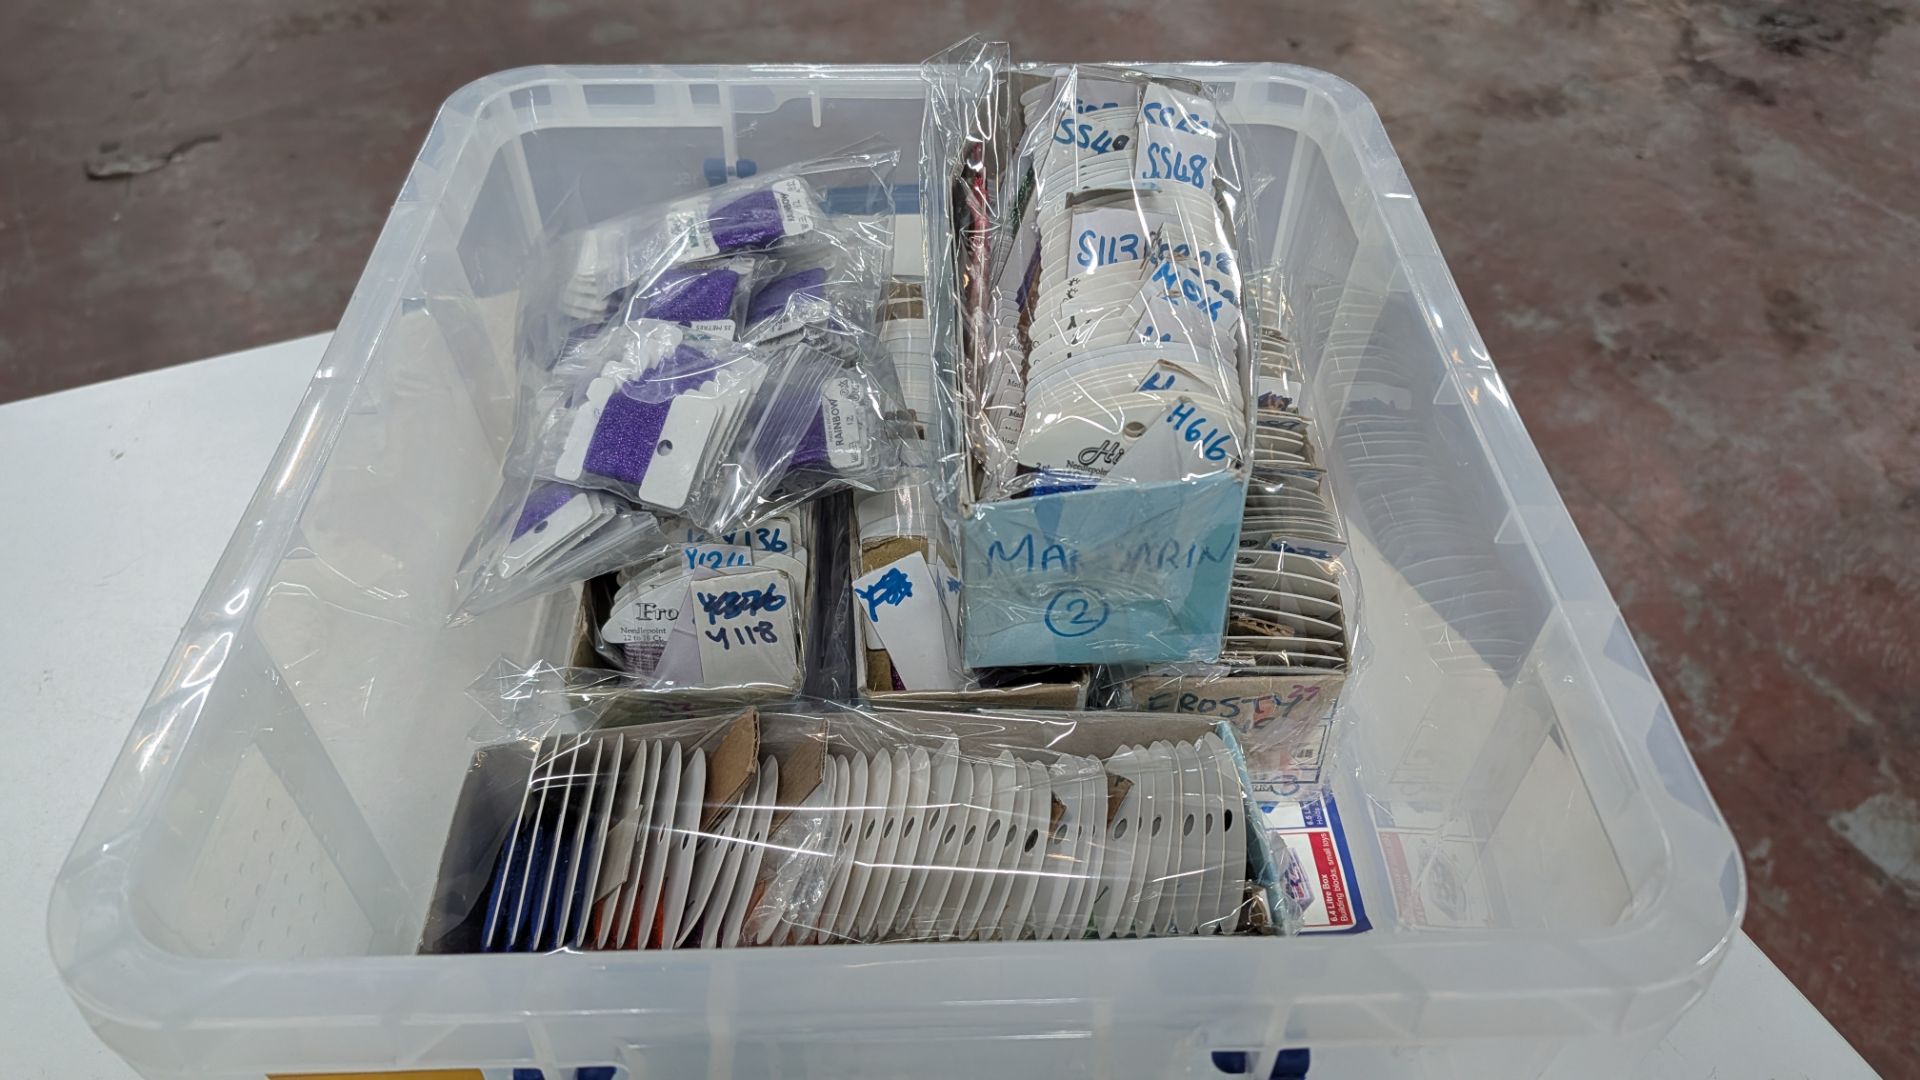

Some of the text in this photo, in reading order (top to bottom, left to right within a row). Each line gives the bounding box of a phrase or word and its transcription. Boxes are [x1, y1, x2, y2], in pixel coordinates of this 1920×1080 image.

[829, 398, 845, 447] RAINBOW
[1166, 403, 1231, 461] H616
[1067, 598, 1098, 624] 2
[620, 627, 666, 635] Needlepoint
[705, 621, 778, 650] Y118
[1321, 833, 1331, 847] toys
[1325, 847, 1335, 867] small
[1321, 874, 1331, 890] Box
[1325, 890, 1336, 910] Litre
[1336, 893, 1349, 922] Building
